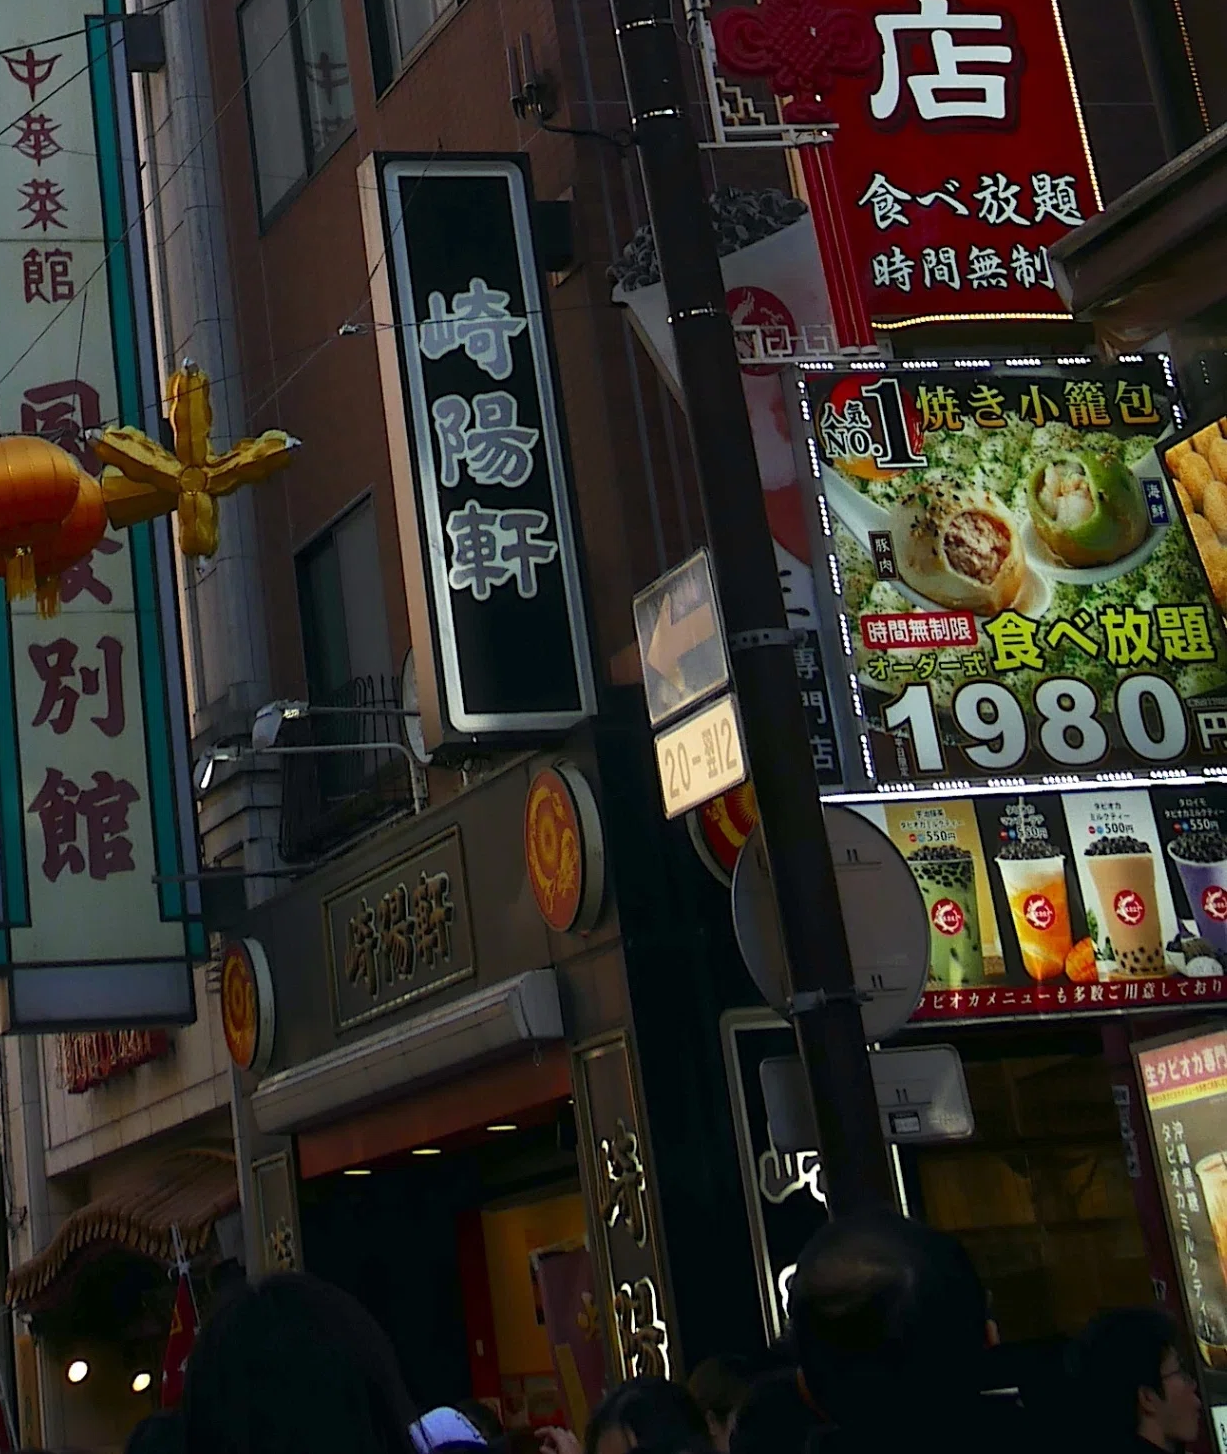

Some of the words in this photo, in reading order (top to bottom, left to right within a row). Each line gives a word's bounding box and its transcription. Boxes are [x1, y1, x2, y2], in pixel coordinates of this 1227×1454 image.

[858, 172, 1086, 229] 食べ放題
[822, 401, 870, 428] 人気
[915, 380, 1164, 432] 焼き小籠包
[420, 277, 558, 600] 崎陽軒
[873, 538, 894, 575] 豚肉
[867, 617, 973, 646] 時間無制限
[984, 605, 1216, 674] 食べ放題
[868, 655, 988, 681] オーダー式
